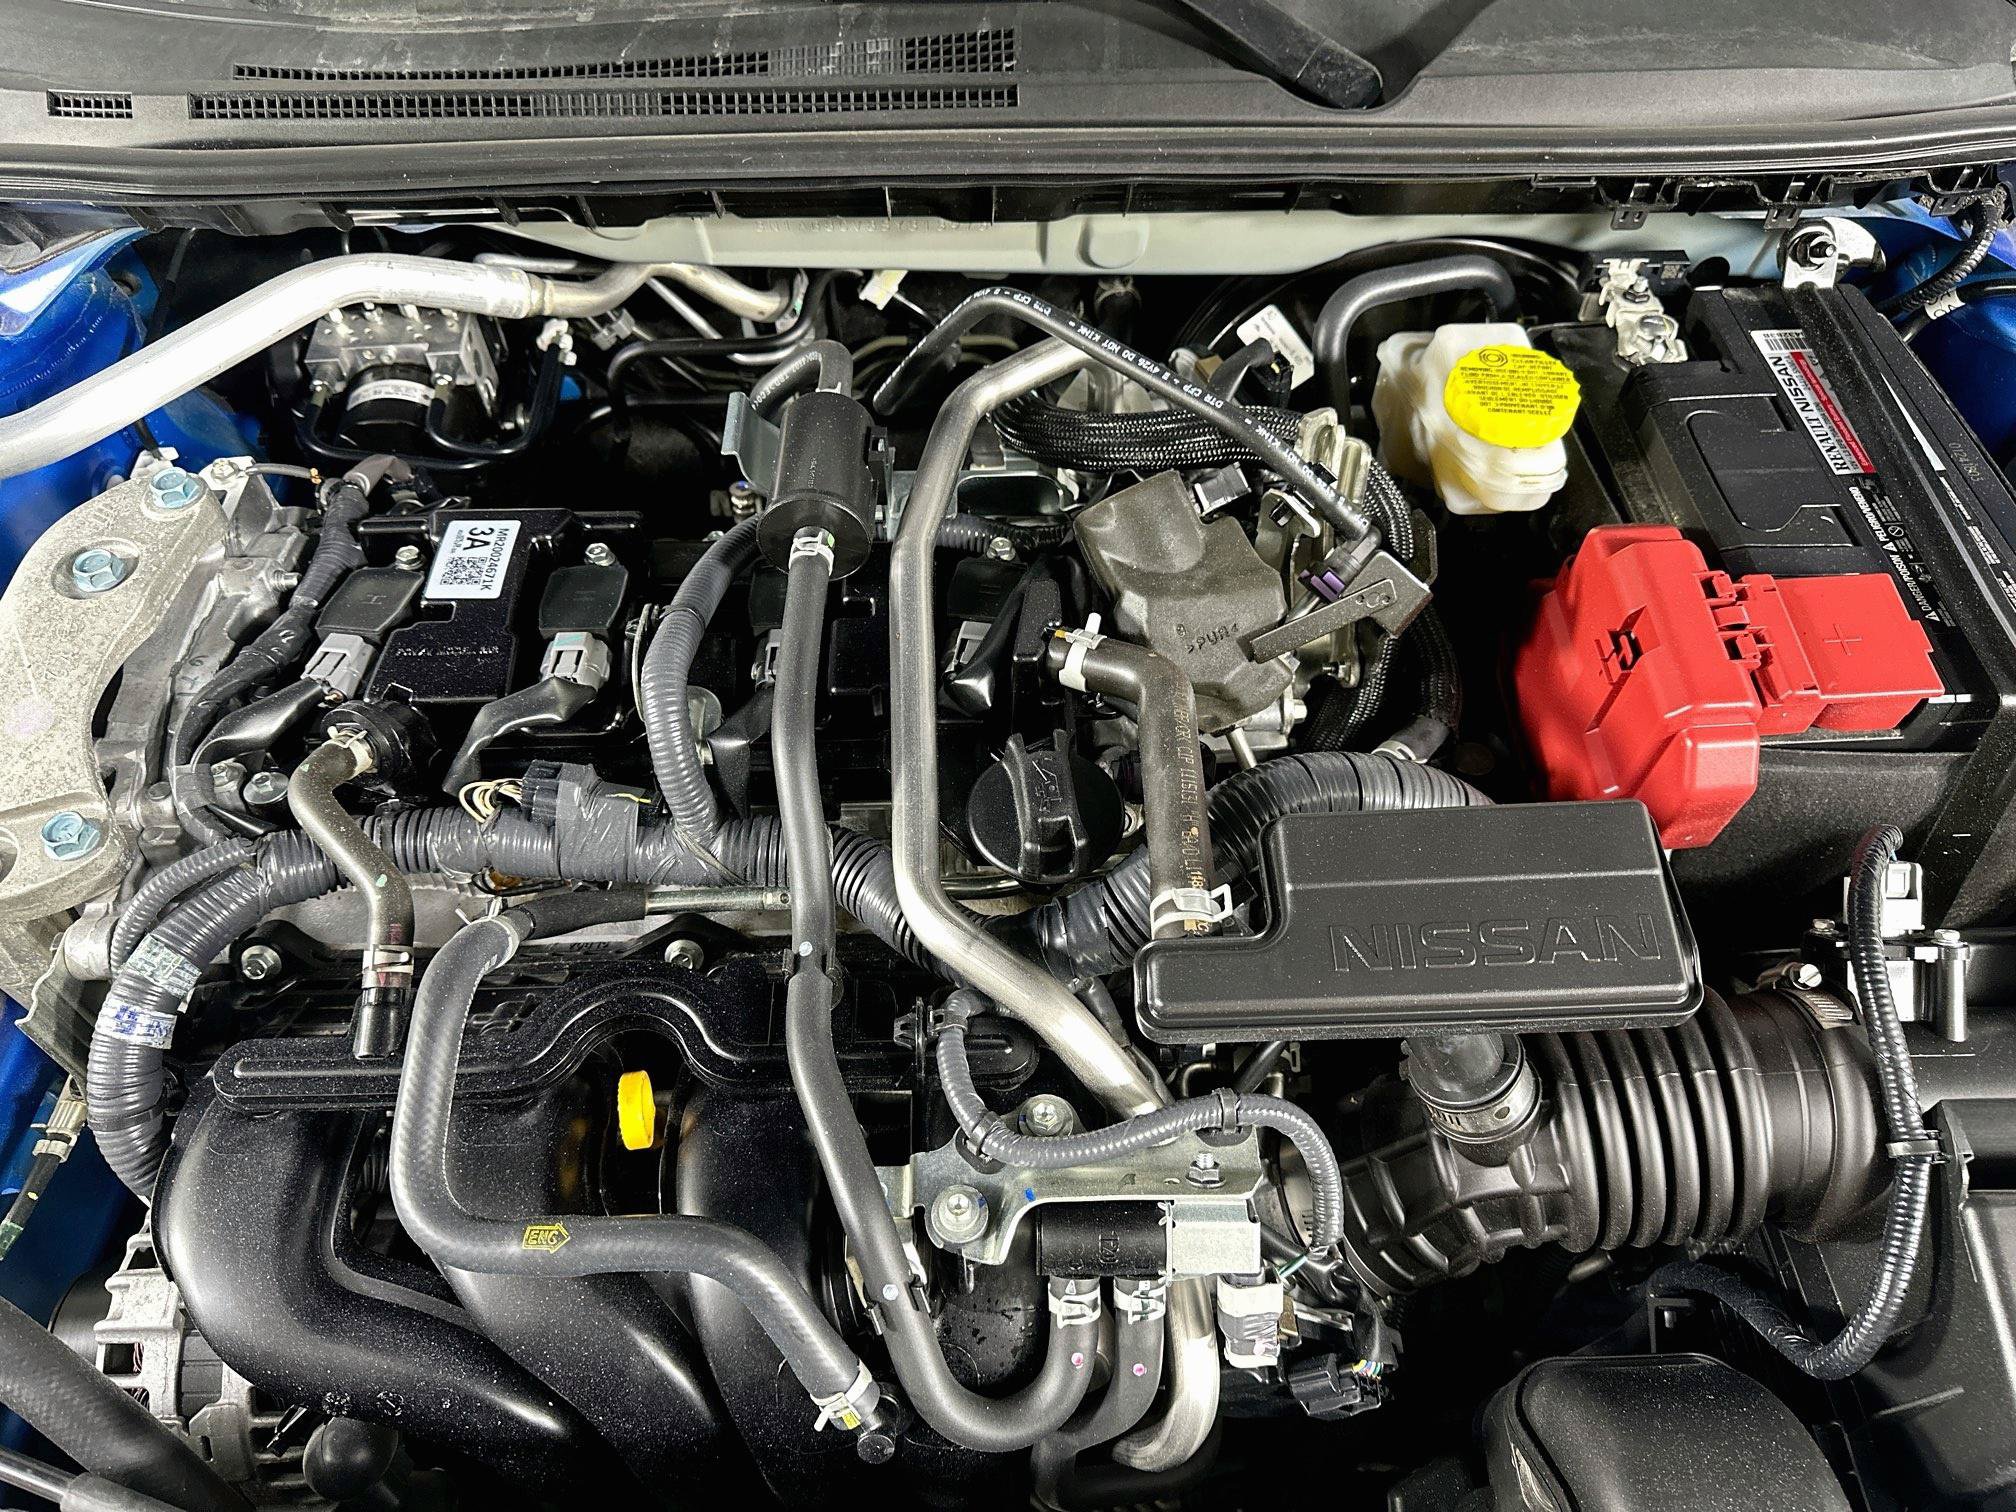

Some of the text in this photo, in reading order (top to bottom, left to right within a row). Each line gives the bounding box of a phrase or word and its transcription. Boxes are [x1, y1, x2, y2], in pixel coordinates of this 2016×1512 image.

[1013, 293, 1032, 305] CFP
[1078, 325, 1100, 342] KINK
[1101, 339, 1121, 353] NOT
[1121, 350, 1136, 362] DO
[1183, 383, 1202, 397] CFP
[1768, 355, 1814, 412] NISSAN
[1203, 394, 1223, 409] DTR
[1255, 426, 1281, 448] KINK
[1805, 416, 1850, 471] RENAULT
[1284, 449, 1300, 466] NOT
[1301, 465, 1314, 479] DO
[1849, 487, 1890, 542] PELIGRO/VENENO
[463, 527, 495, 551] 3A
[481, 528, 510, 590] MR20024671K
[1329, 914, 1661, 971] NISSAN
[528, 1230, 558, 1245] ENG
